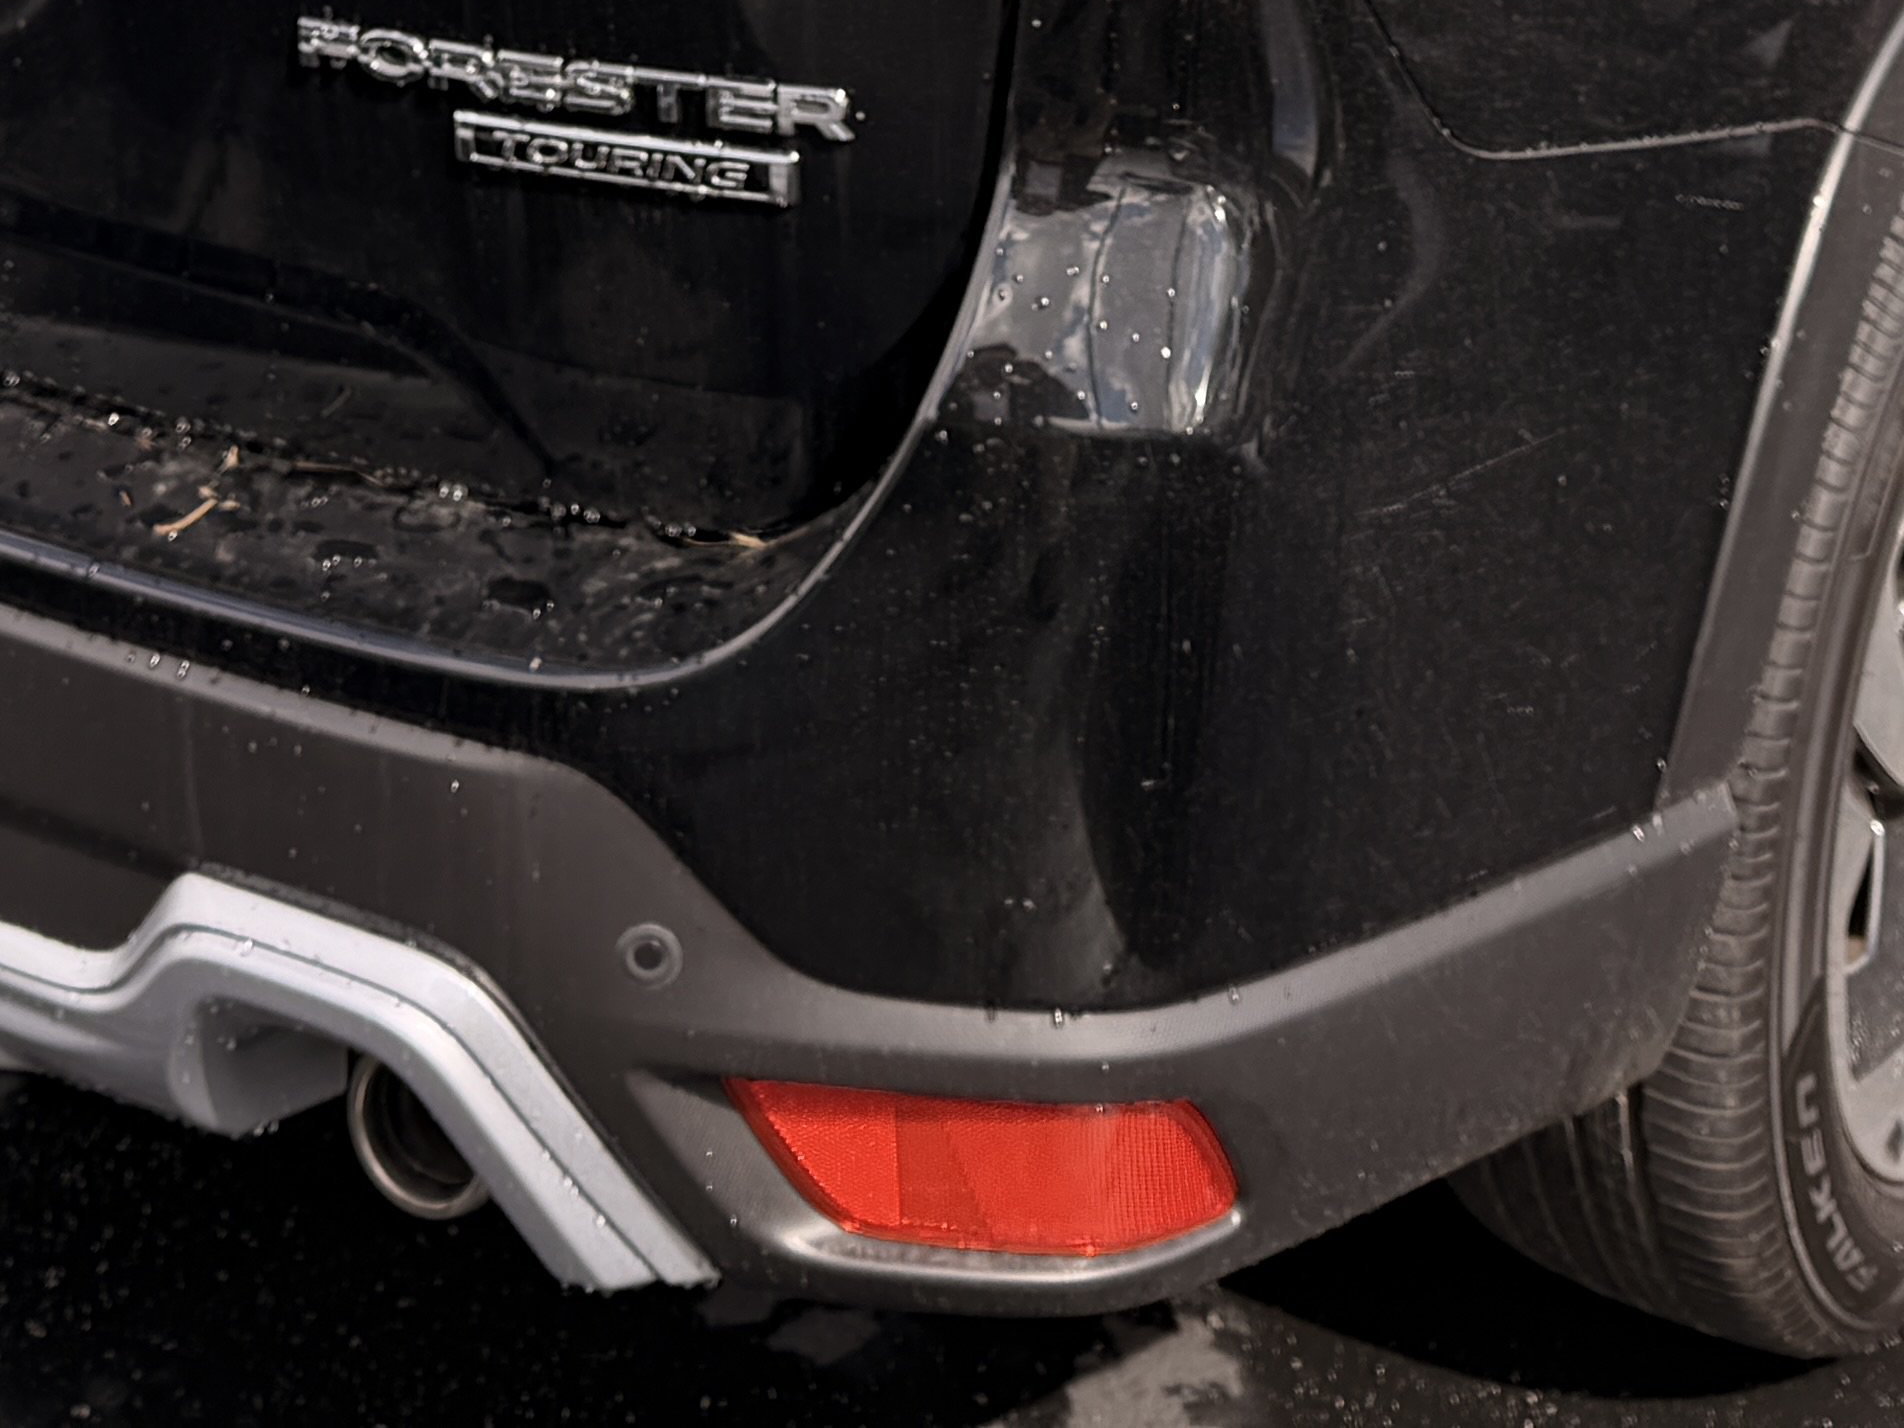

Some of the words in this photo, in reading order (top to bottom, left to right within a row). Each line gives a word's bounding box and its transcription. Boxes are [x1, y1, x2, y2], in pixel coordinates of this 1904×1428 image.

[297, 16, 856, 142] FORESTER
[494, 130, 751, 190] TOURING
[1797, 1073, 1879, 1293] FALKEN
